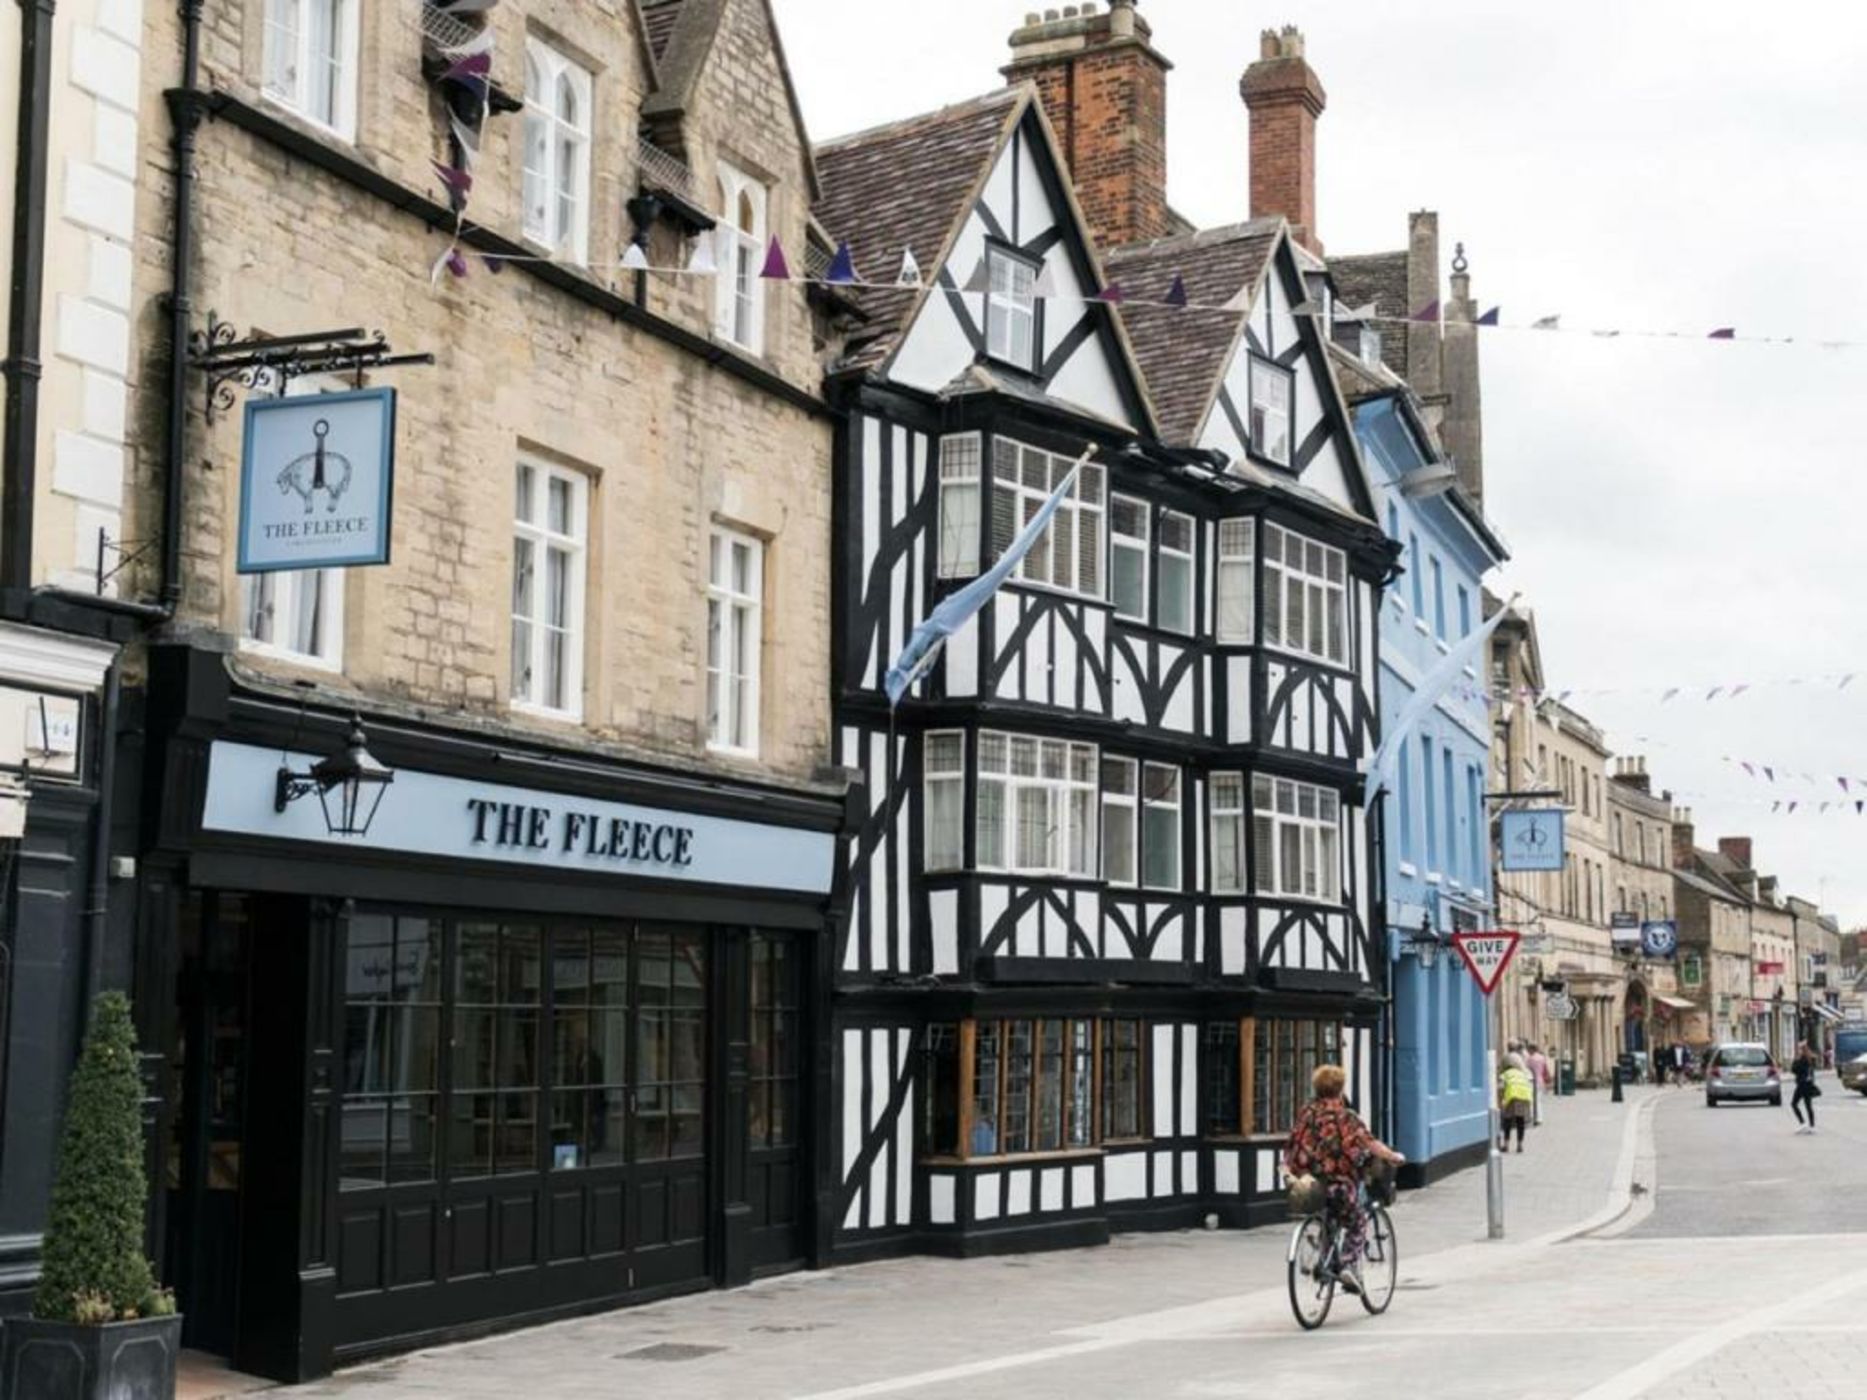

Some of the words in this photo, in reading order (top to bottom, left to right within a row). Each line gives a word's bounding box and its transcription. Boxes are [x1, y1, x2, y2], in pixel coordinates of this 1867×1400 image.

[263, 522, 298, 539] THE
[304, 517, 368, 536] FLEECE
[467, 798, 550, 850] THE
[562, 812, 694, 866] FLEECE
[1466, 941, 1503, 953] GIVE
[1476, 957, 1499, 965] WAY
